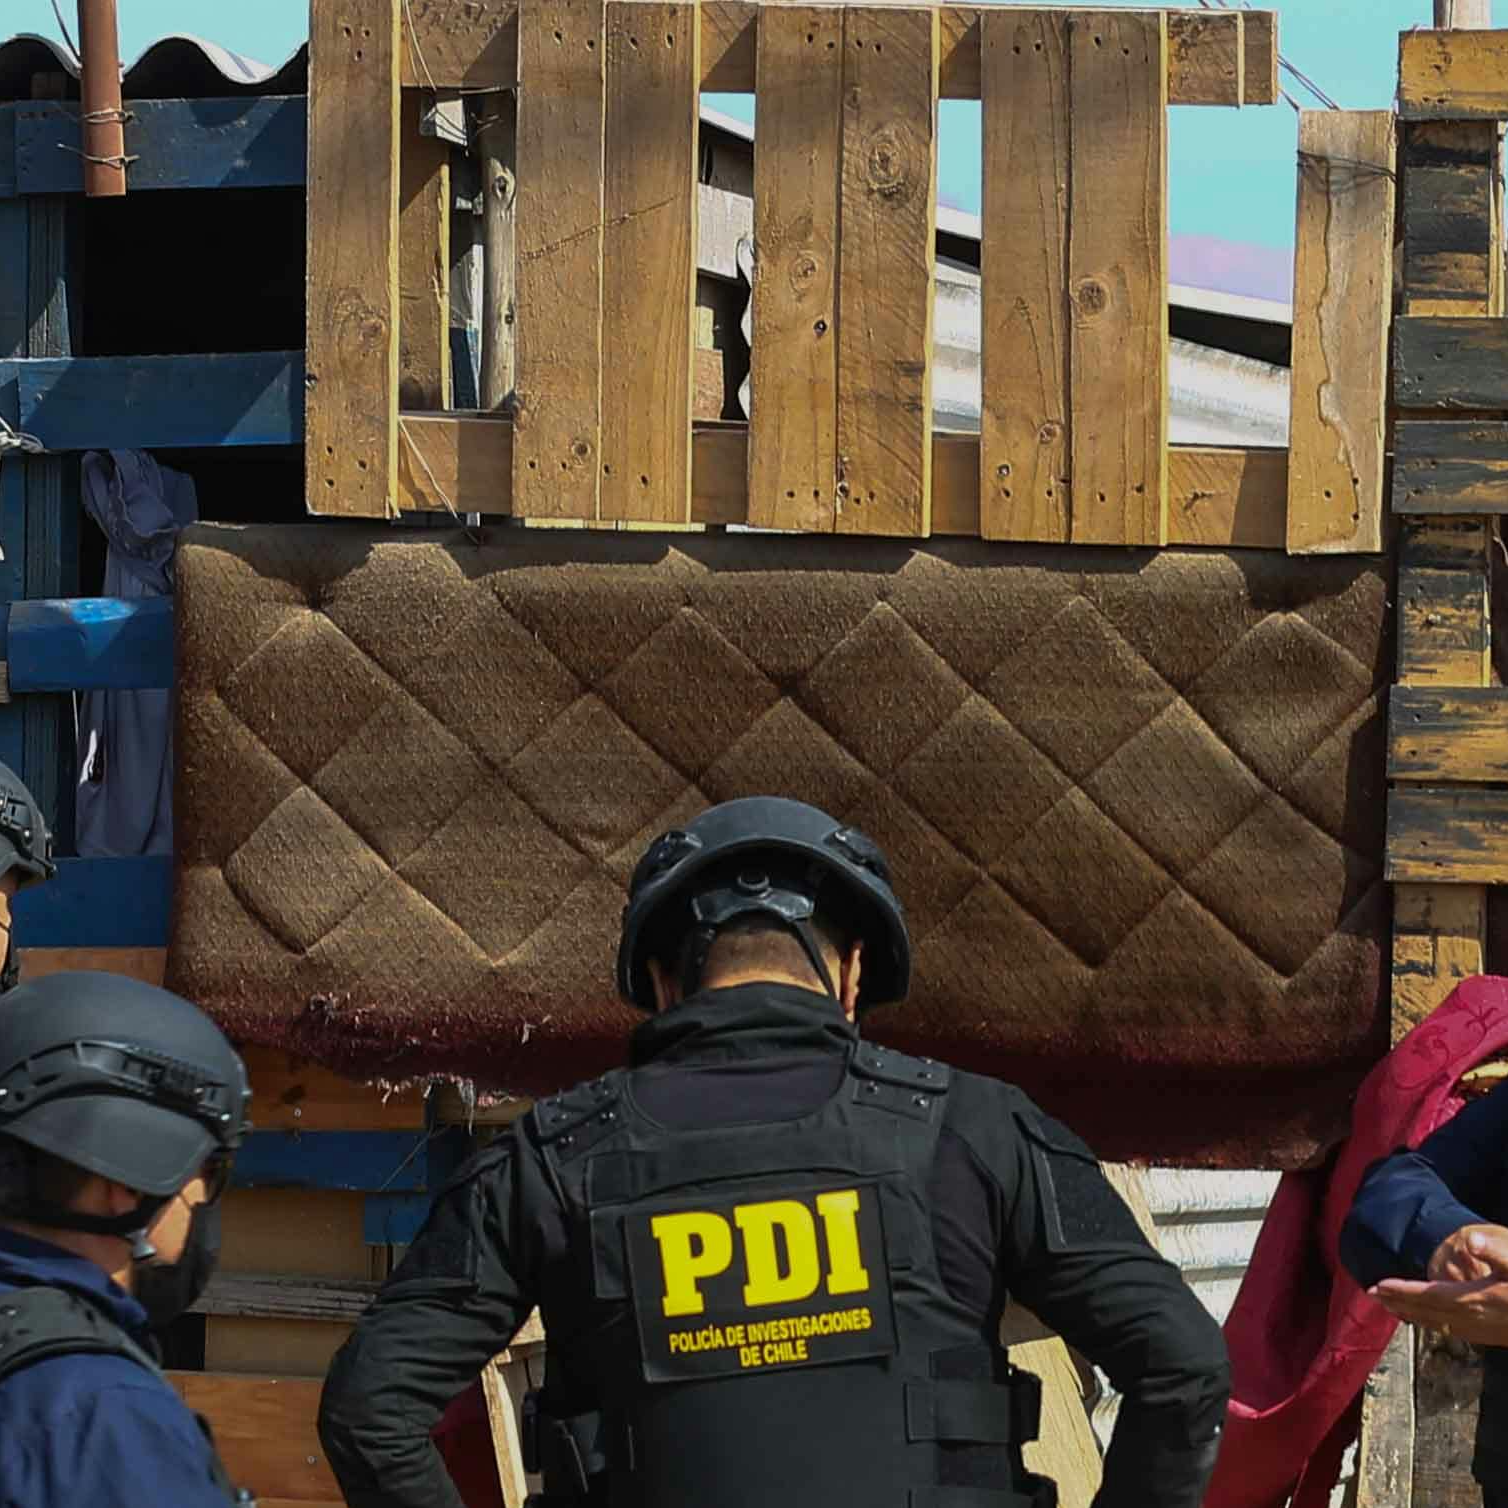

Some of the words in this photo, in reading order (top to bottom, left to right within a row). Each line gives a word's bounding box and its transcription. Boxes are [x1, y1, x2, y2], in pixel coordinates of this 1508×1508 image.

[651, 1189, 869, 1317] PDI
[669, 1323, 725, 1353] POLICÍA
[726, 1325, 746, 1346] DE
[747, 1307, 872, 1343] INVESTIGACIONES
[740, 1346, 762, 1367] DE
[763, 1340, 808, 1364] CHILE
